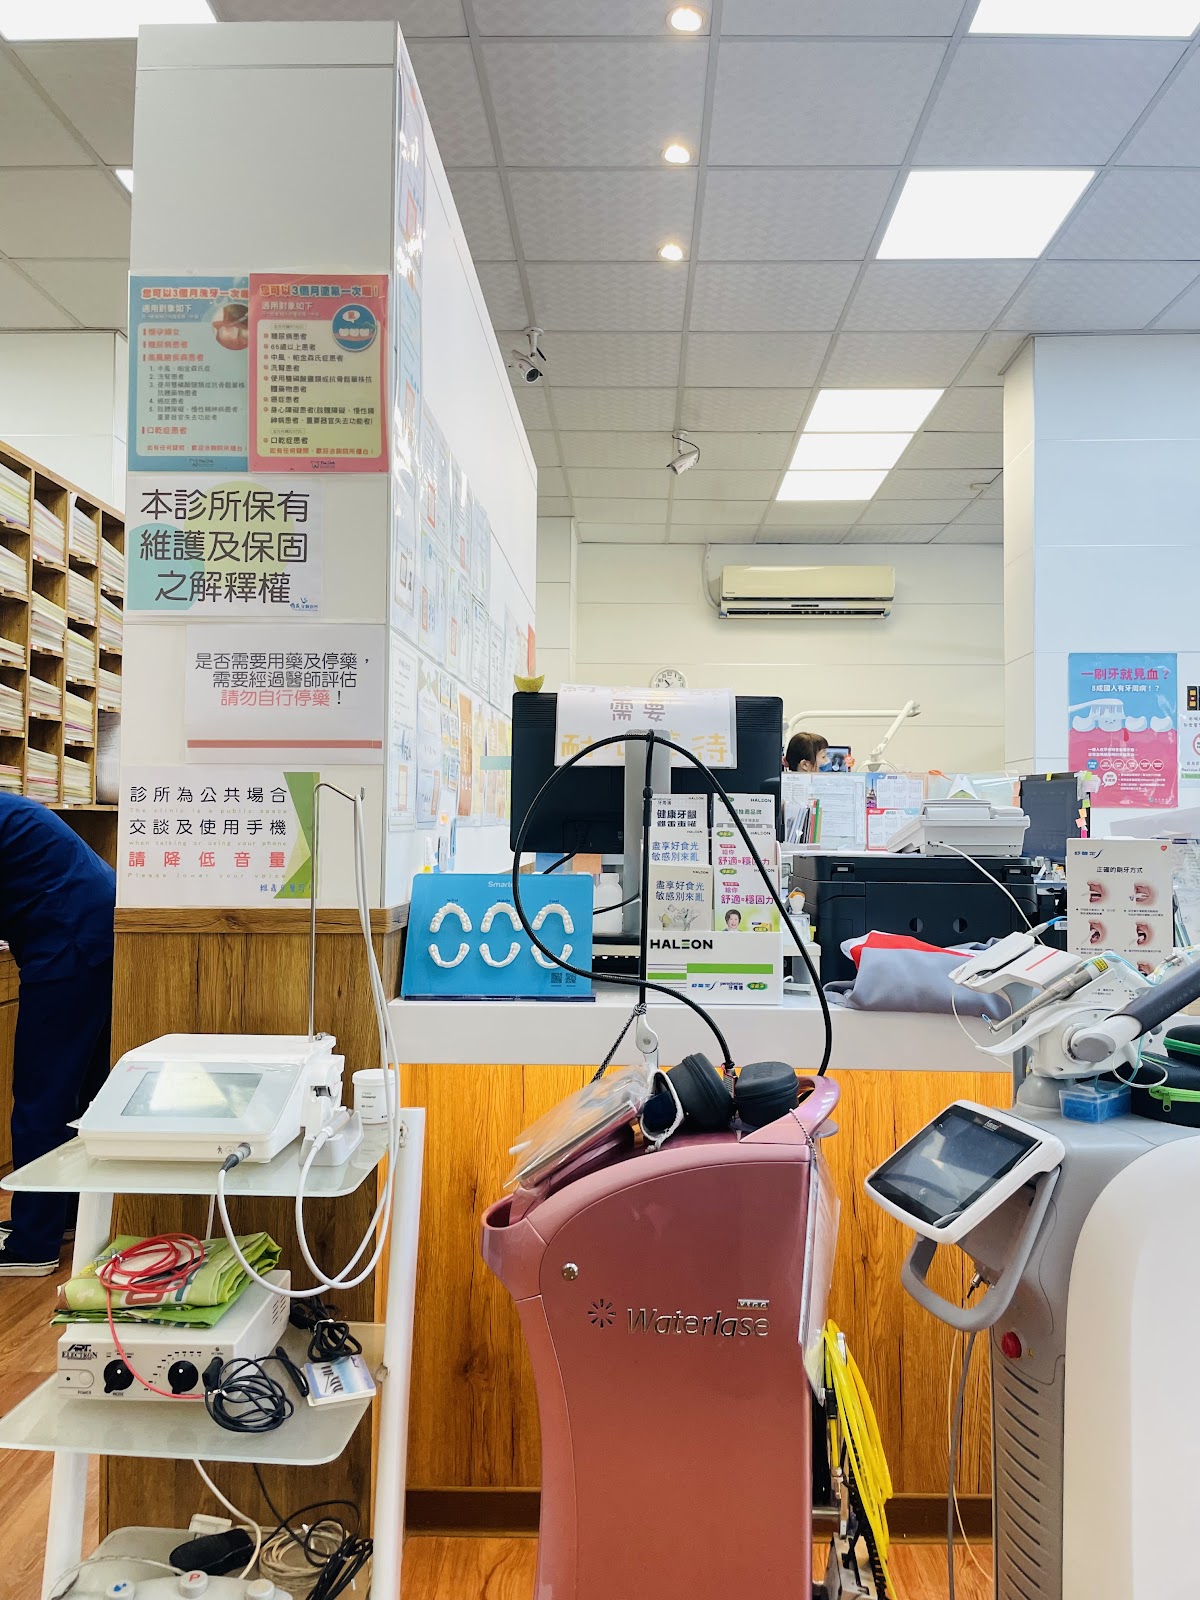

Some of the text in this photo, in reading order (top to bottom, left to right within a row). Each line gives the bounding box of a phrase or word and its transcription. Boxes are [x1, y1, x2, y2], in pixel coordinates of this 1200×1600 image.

[140, 488, 310, 523] 本診所保有
[139, 530, 308, 563] 維護及保固
[155, 570, 291, 603] 之解釋權
[195, 652, 369, 670] 是否需要用藥及停藥，
[212, 671, 357, 689] 需要經過醫師評估
[1081, 668, 1169, 680] 一刷牙就見血？
[221, 689, 342, 707] 請勿自行停藥！
[610, 698, 665, 723] 需要
[130, 786, 287, 803] 診所為公共場合
[657, 809, 697, 819] 健康牙齦
[129, 819, 287, 836] 交談及使用手機
[652, 841, 699, 851] 盡享好食光
[128, 851, 286, 868] 請降低音量
[652, 852, 699, 862] 敏感別來亂
[655, 880, 705, 891] 盡享好食光
[655, 891, 705, 902] 敏感別來亂
[650, 939, 713, 950] HALEON
[626, 1308, 770, 1337] Waterlase
[61, 1351, 98, 1359] ELECTRON
